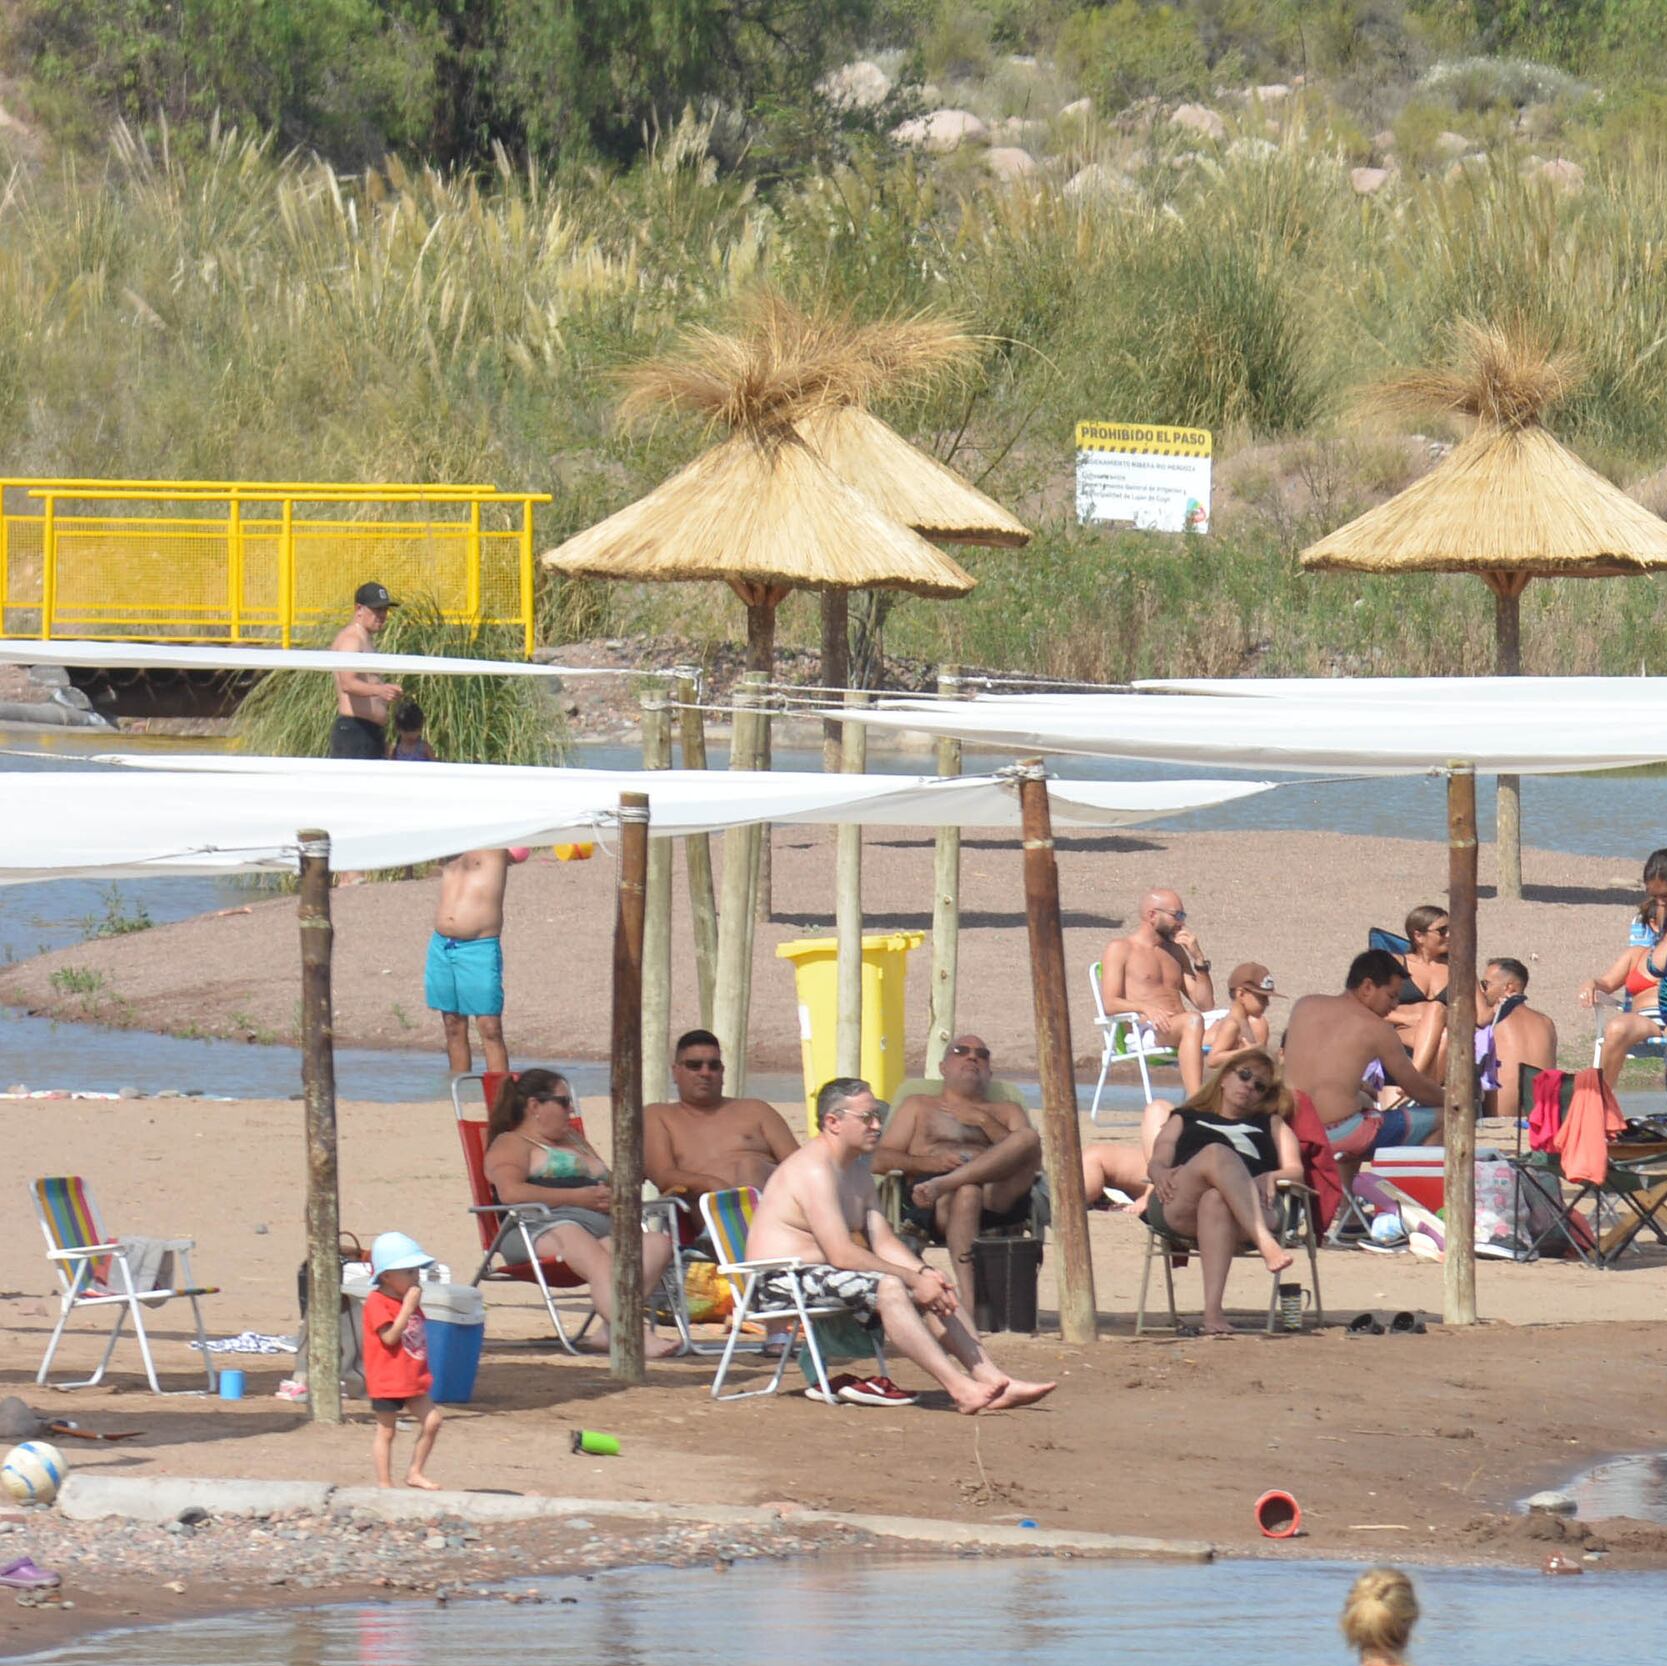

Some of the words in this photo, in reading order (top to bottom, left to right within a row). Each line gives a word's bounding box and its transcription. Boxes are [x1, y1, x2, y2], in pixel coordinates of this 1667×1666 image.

[1081, 426, 1153, 442] PROHIBIDO
[1157, 431, 1171, 443] EL
[1173, 432, 1205, 445] PASO
